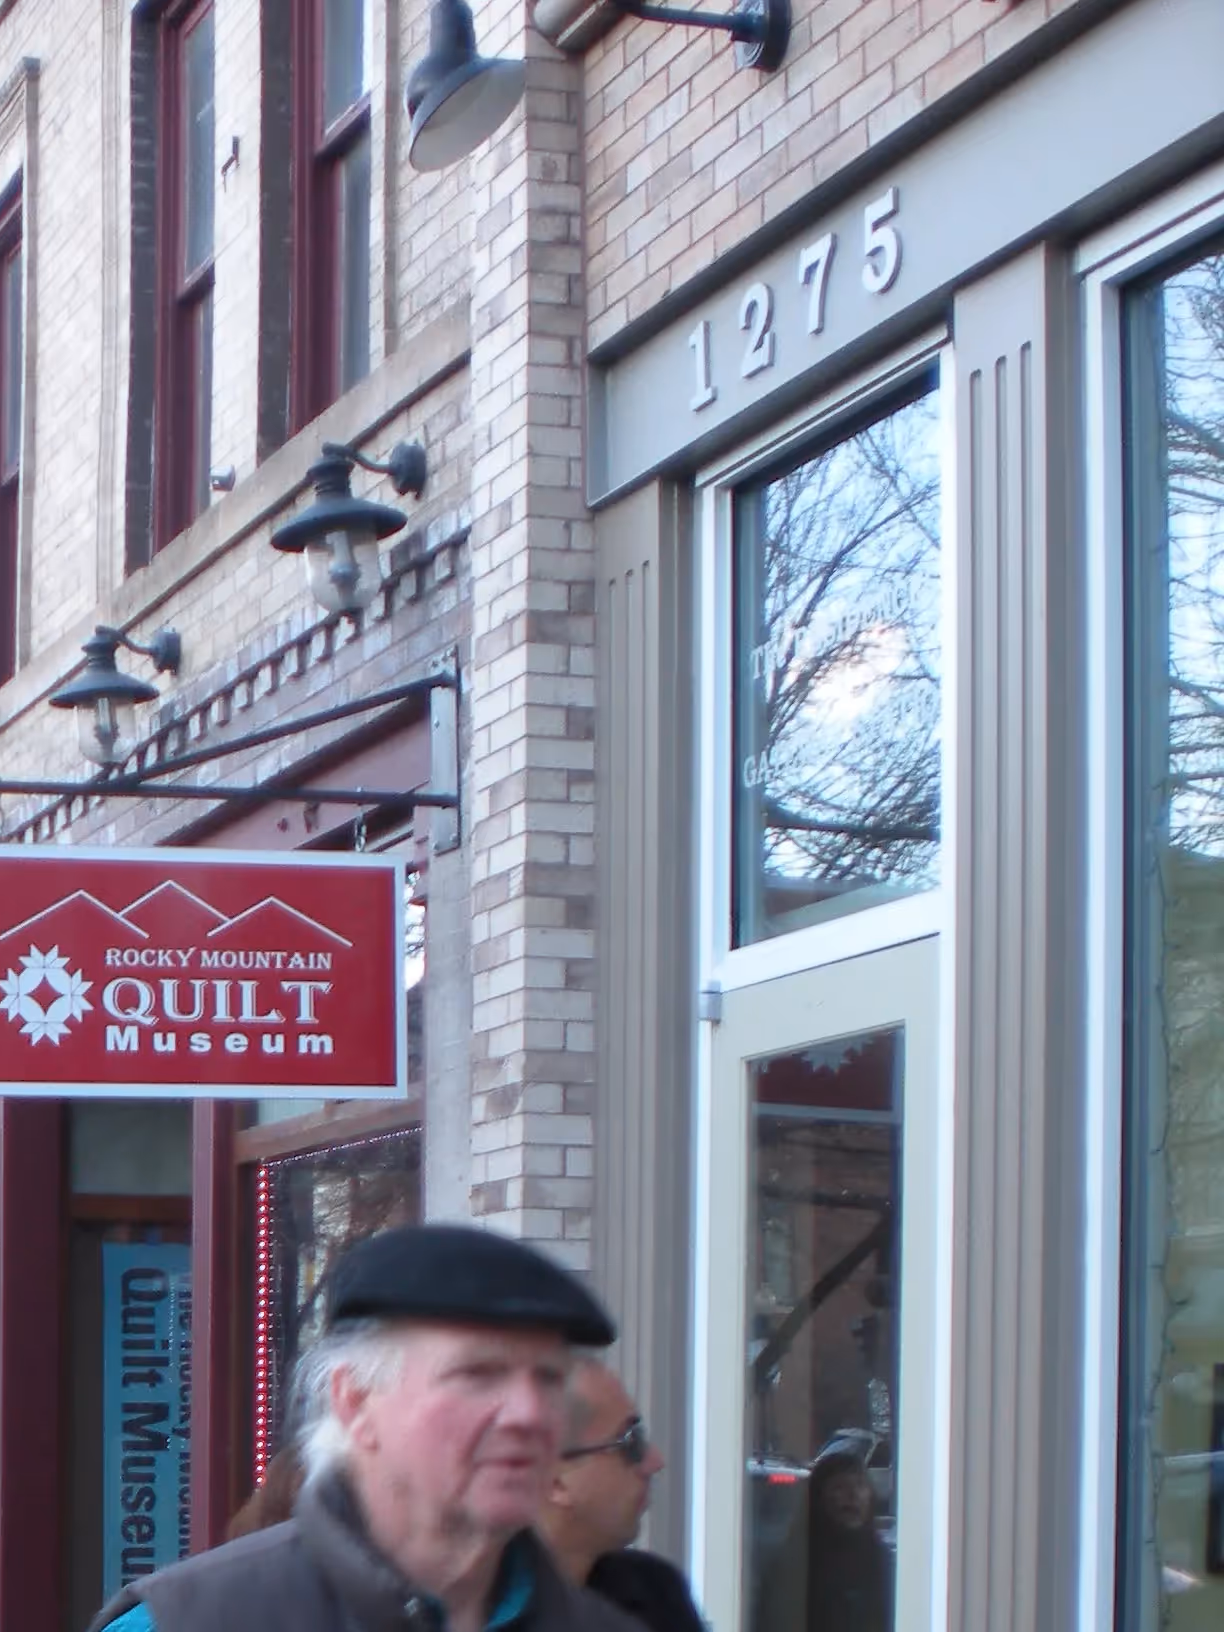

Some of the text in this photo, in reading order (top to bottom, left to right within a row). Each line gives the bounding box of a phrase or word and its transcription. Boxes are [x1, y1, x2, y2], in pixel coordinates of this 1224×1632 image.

[688, 186, 902, 412] 1275
[105, 946, 332, 971] ROCKY MOUNTAIN
[101, 976, 333, 1026] QUILT
[104, 1024, 334, 1055] Museum
[121, 1267, 170, 1589] Quilt Museu
